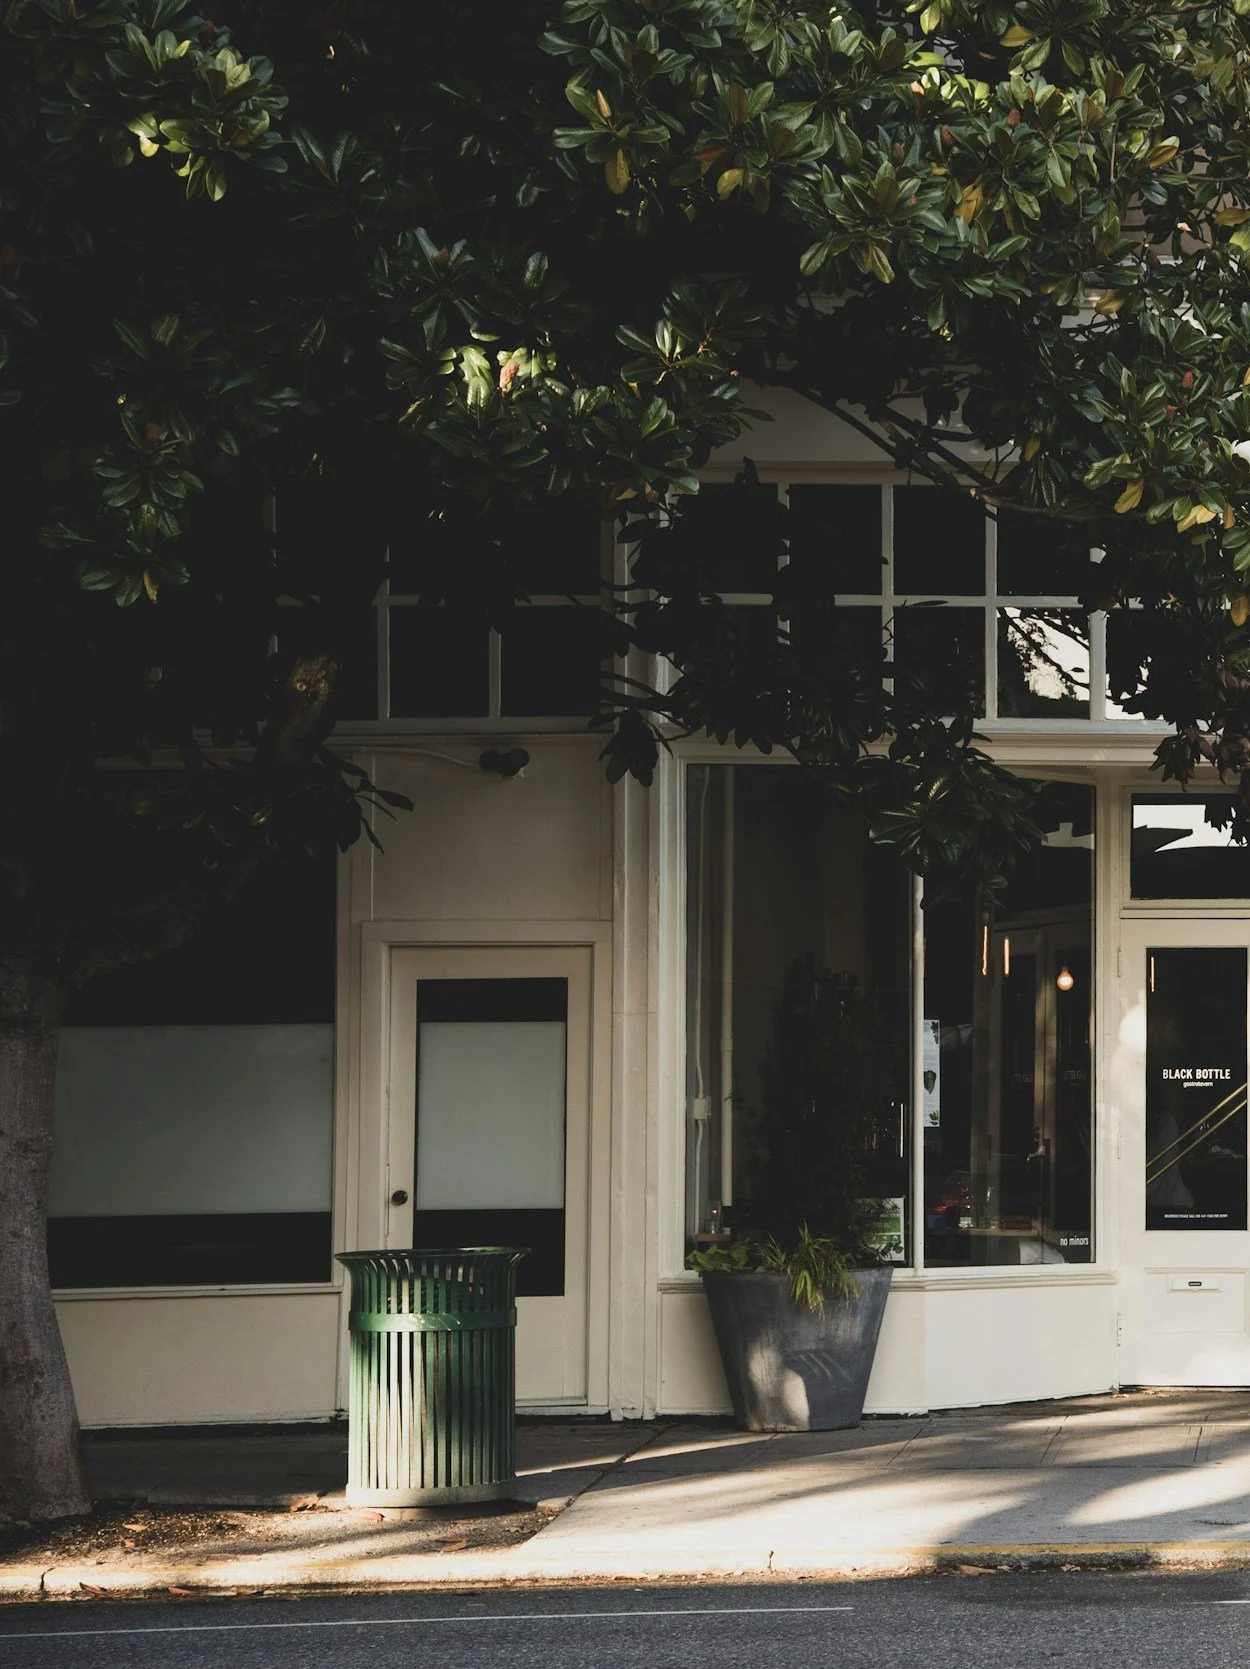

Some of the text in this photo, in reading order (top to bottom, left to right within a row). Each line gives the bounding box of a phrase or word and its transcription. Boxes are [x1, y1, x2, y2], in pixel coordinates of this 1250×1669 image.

[1162, 1068, 1231, 1080] BLACK BOTTLE
[1183, 1081, 1214, 1089] gastrotavern
[1060, 1235, 1089, 1246] no minors
